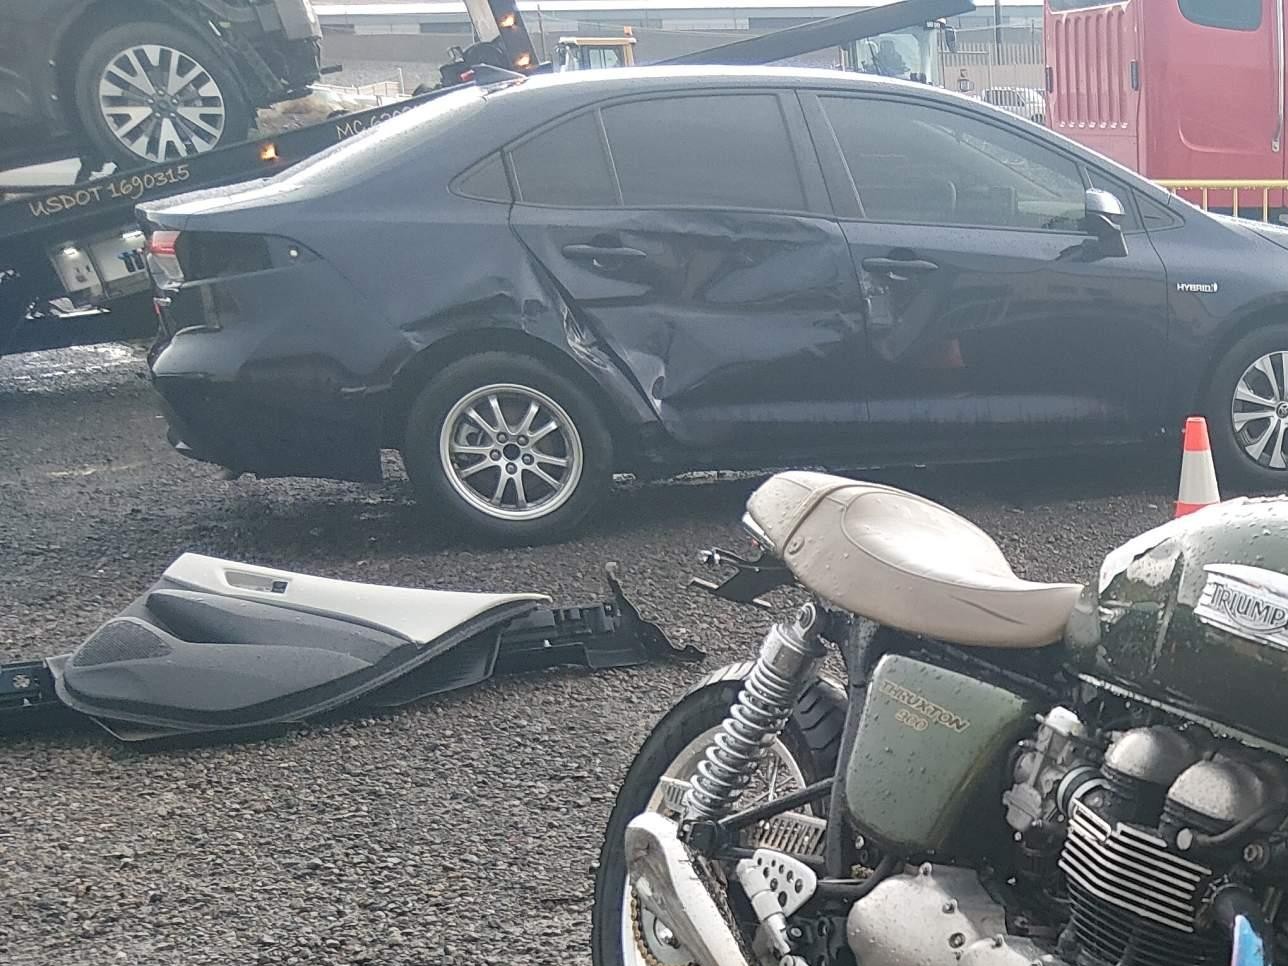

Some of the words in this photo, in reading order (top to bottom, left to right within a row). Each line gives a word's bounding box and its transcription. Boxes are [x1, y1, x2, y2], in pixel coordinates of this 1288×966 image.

[29, 185, 103, 217] USDOT
[107, 163, 190, 200] 1690315
[1176, 282, 1212, 293] HYBRID
[878, 679, 971, 734] THRUXTON
